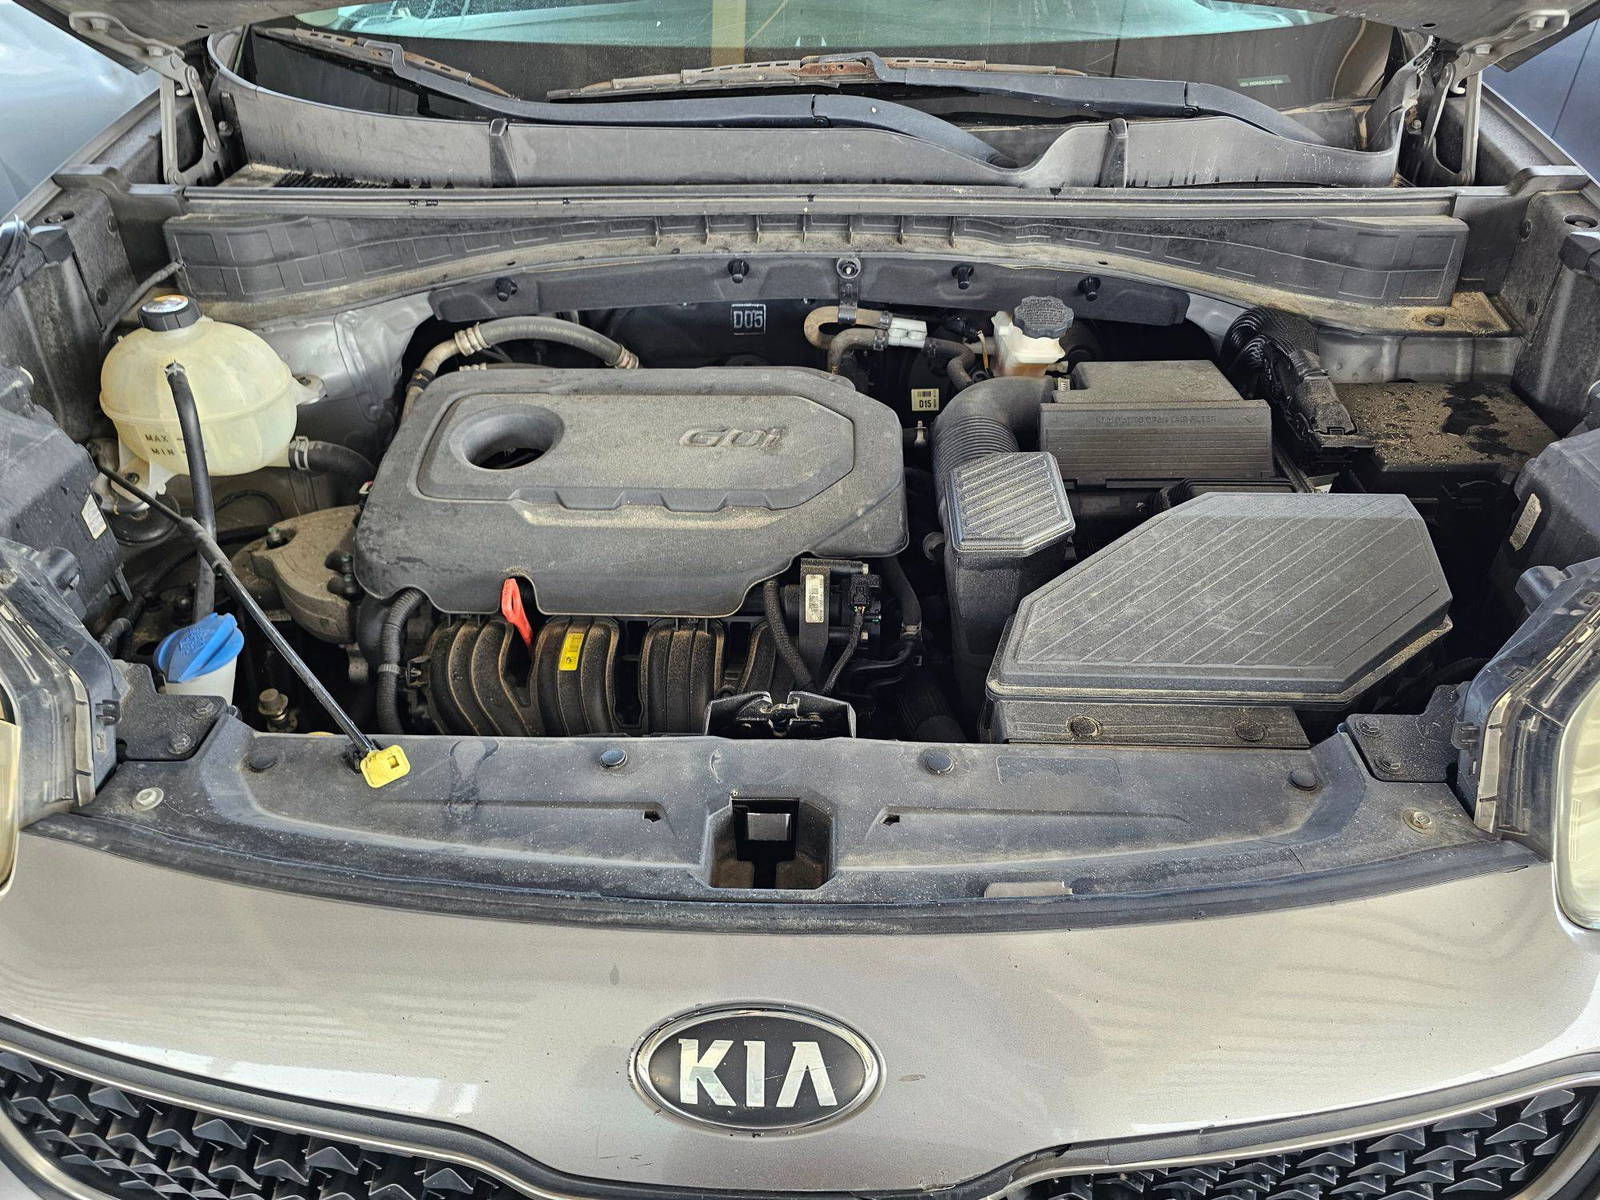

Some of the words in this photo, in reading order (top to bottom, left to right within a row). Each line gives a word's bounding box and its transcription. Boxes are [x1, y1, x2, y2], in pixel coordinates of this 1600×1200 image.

[733, 310, 763, 328] D05
[144, 433, 169, 443] MAX
[679, 427, 785, 451] GDi
[150, 447, 175, 456] MIN
[678, 1038, 838, 1108] KIA
